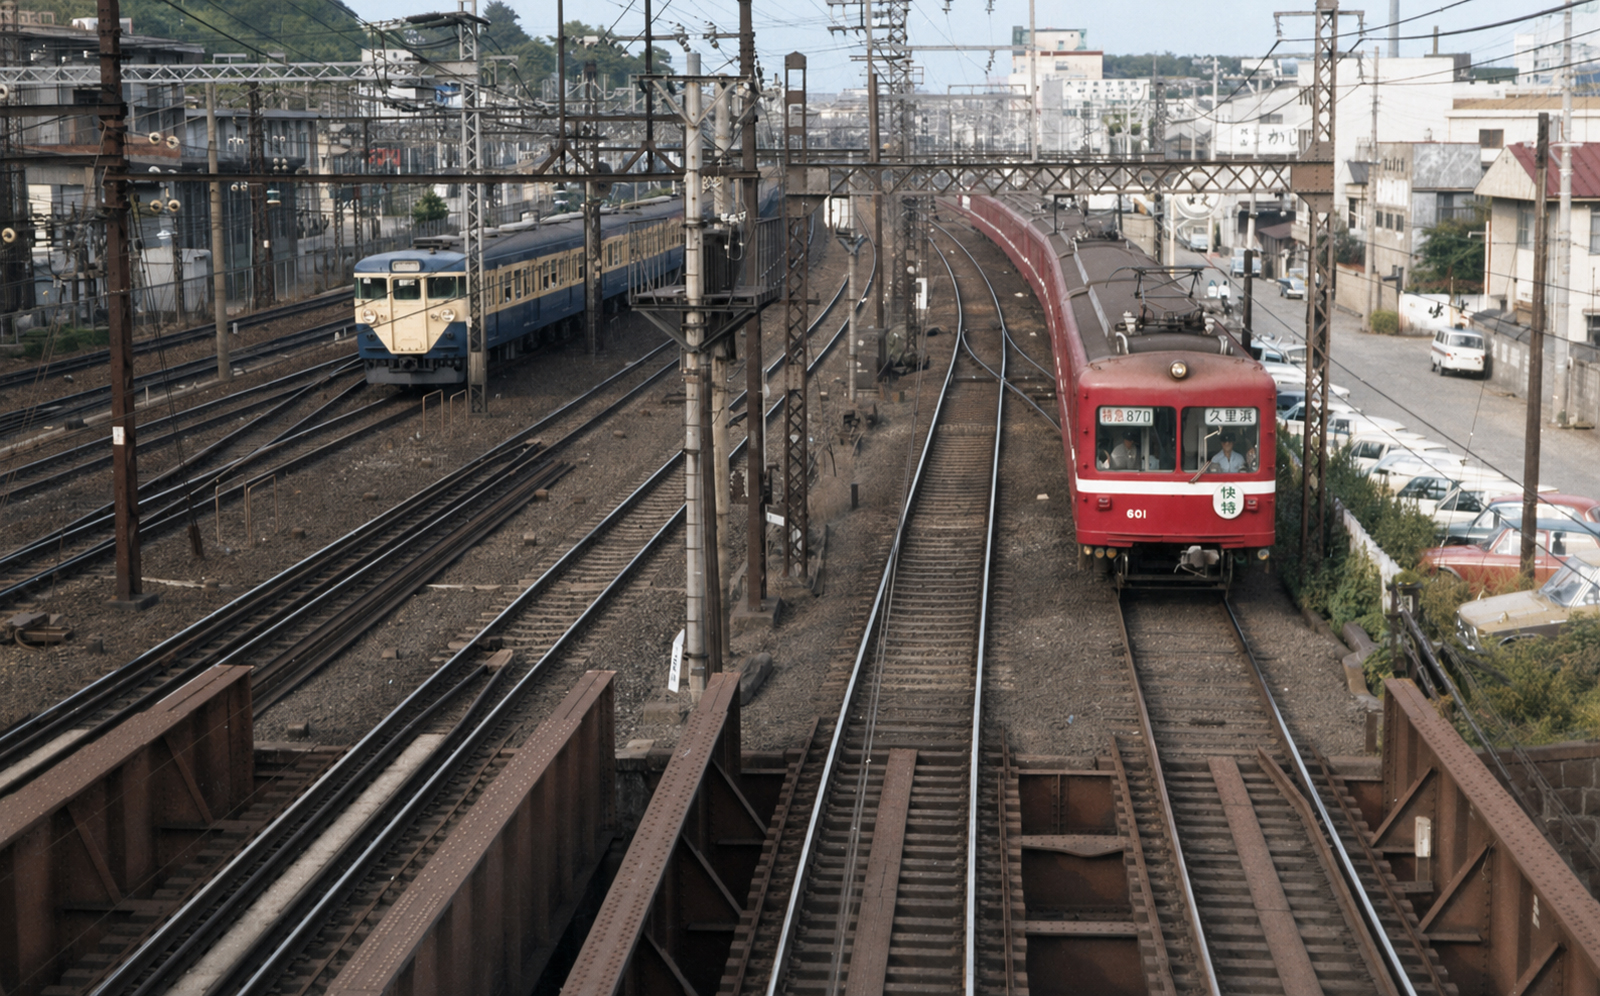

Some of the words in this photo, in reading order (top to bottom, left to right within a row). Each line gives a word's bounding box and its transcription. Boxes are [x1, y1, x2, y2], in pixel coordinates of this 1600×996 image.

[1209, 408, 1253, 423] 久里浜
[1220, 486, 1236, 515] 快特
[1126, 508, 1147, 519] 601
